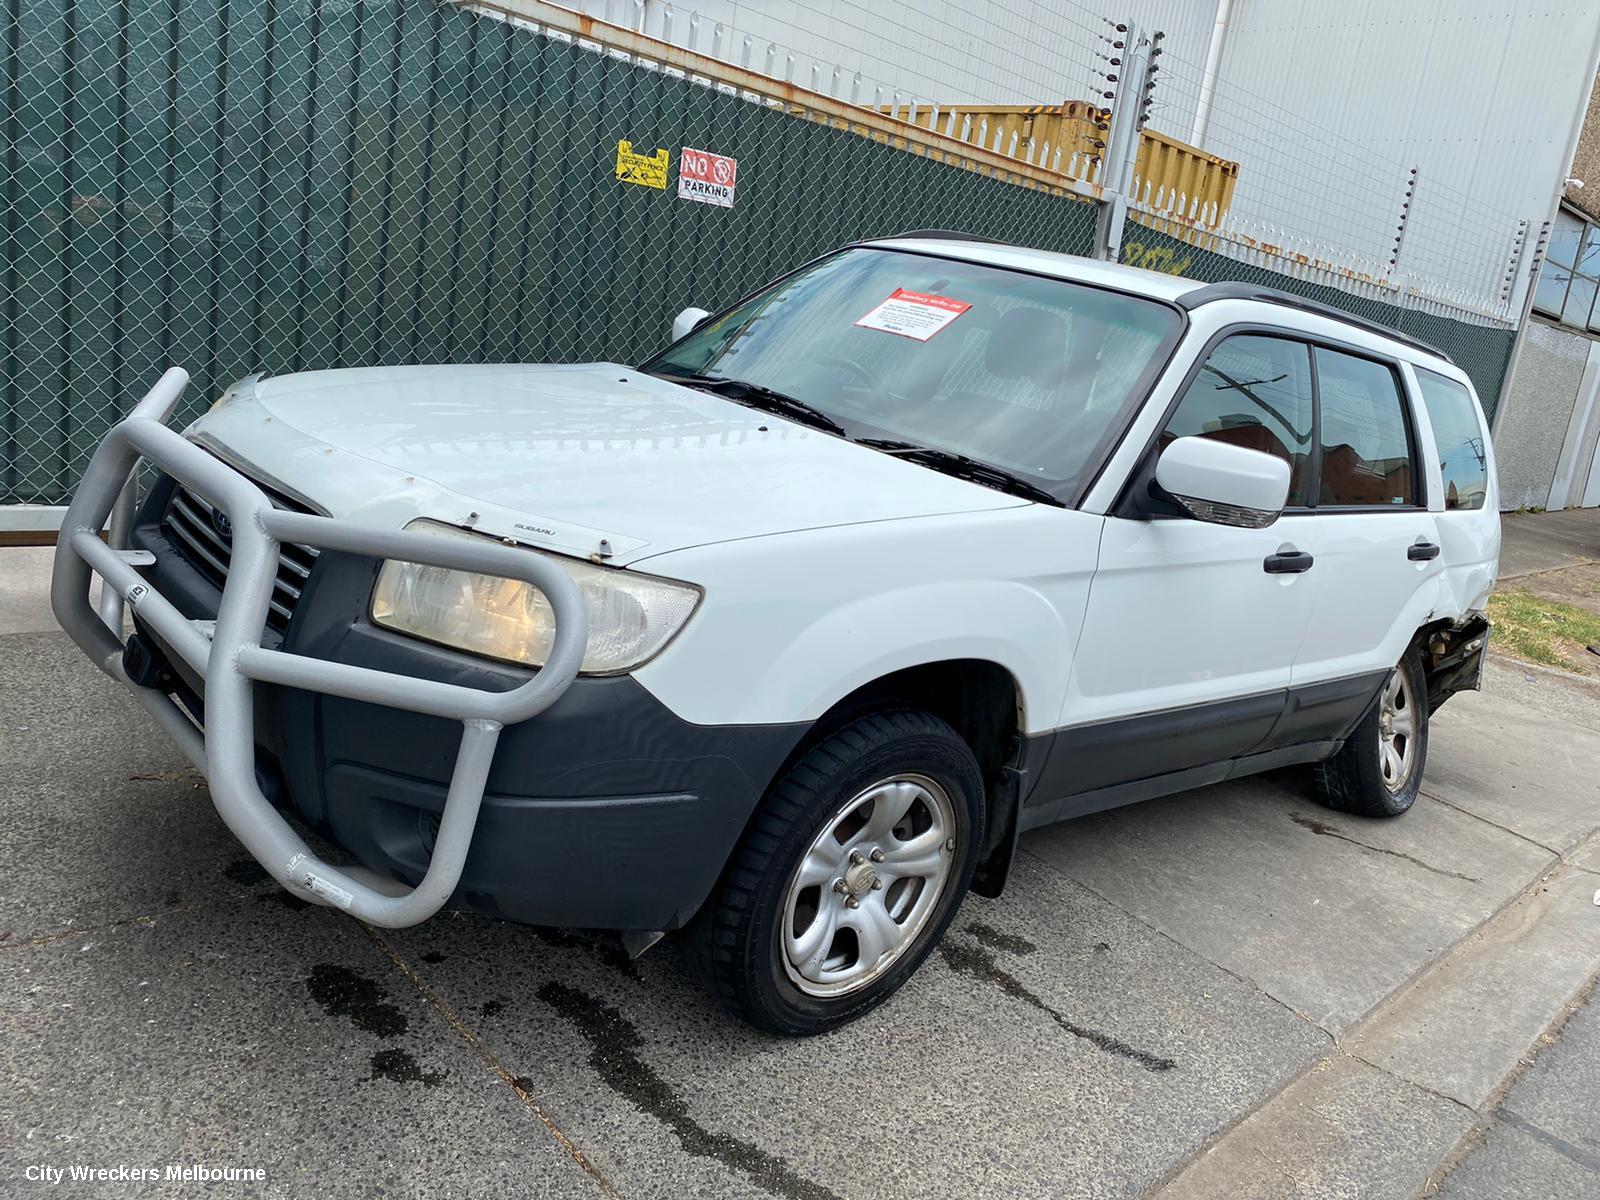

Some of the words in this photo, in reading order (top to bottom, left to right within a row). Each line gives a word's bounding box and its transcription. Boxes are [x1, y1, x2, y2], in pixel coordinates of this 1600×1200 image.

[684, 154, 708, 176] NO
[685, 180, 728, 198] PARKING
[513, 523, 556, 536] SUBARU
